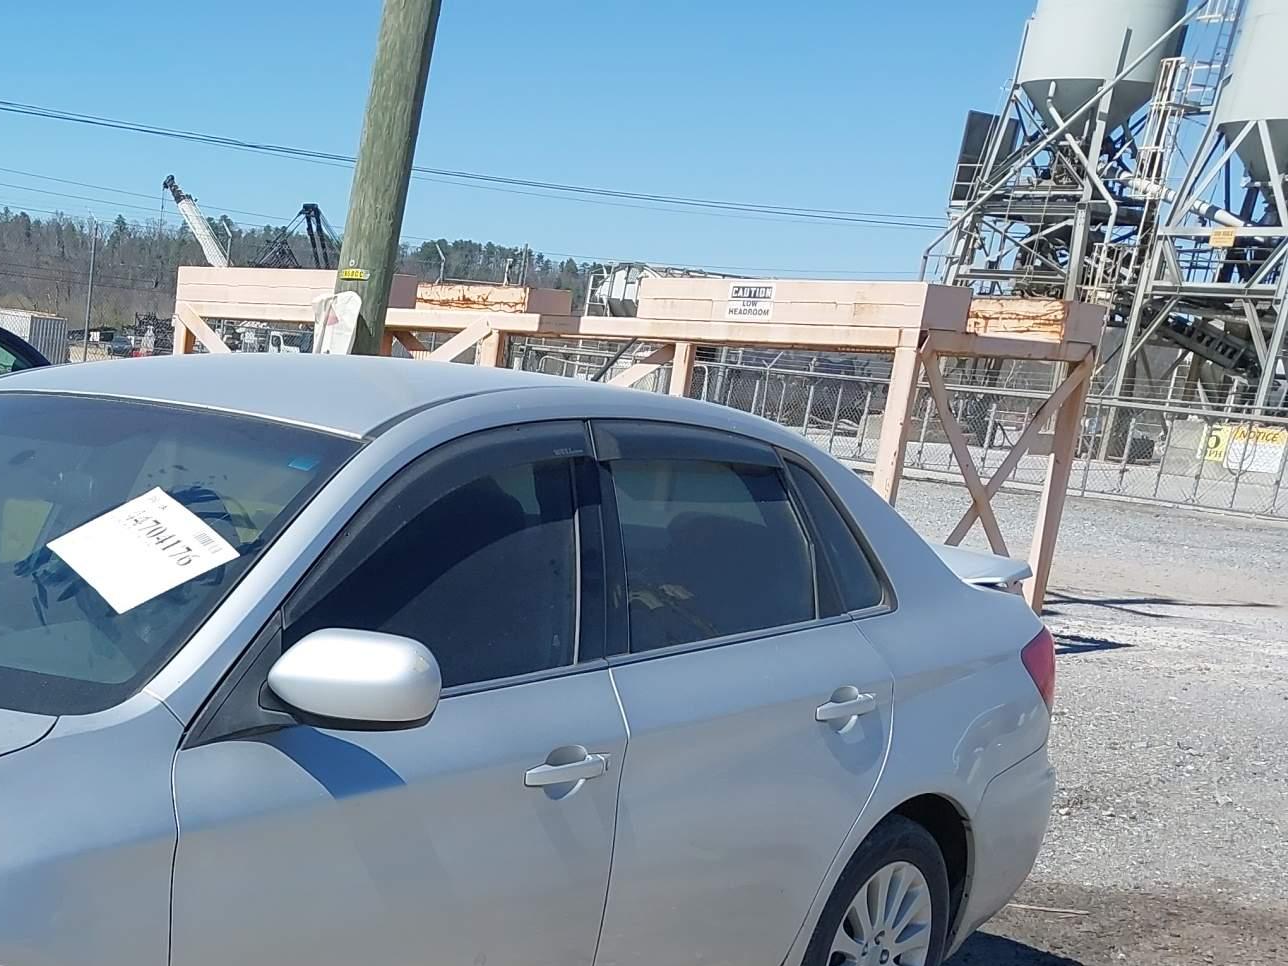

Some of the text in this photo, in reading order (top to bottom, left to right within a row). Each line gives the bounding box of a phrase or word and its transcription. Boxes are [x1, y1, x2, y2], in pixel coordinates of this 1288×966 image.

[732, 286, 772, 298] CAUTION
[728, 307, 769, 316] HEADROOM
[1238, 430, 1280, 442] NOTICE
